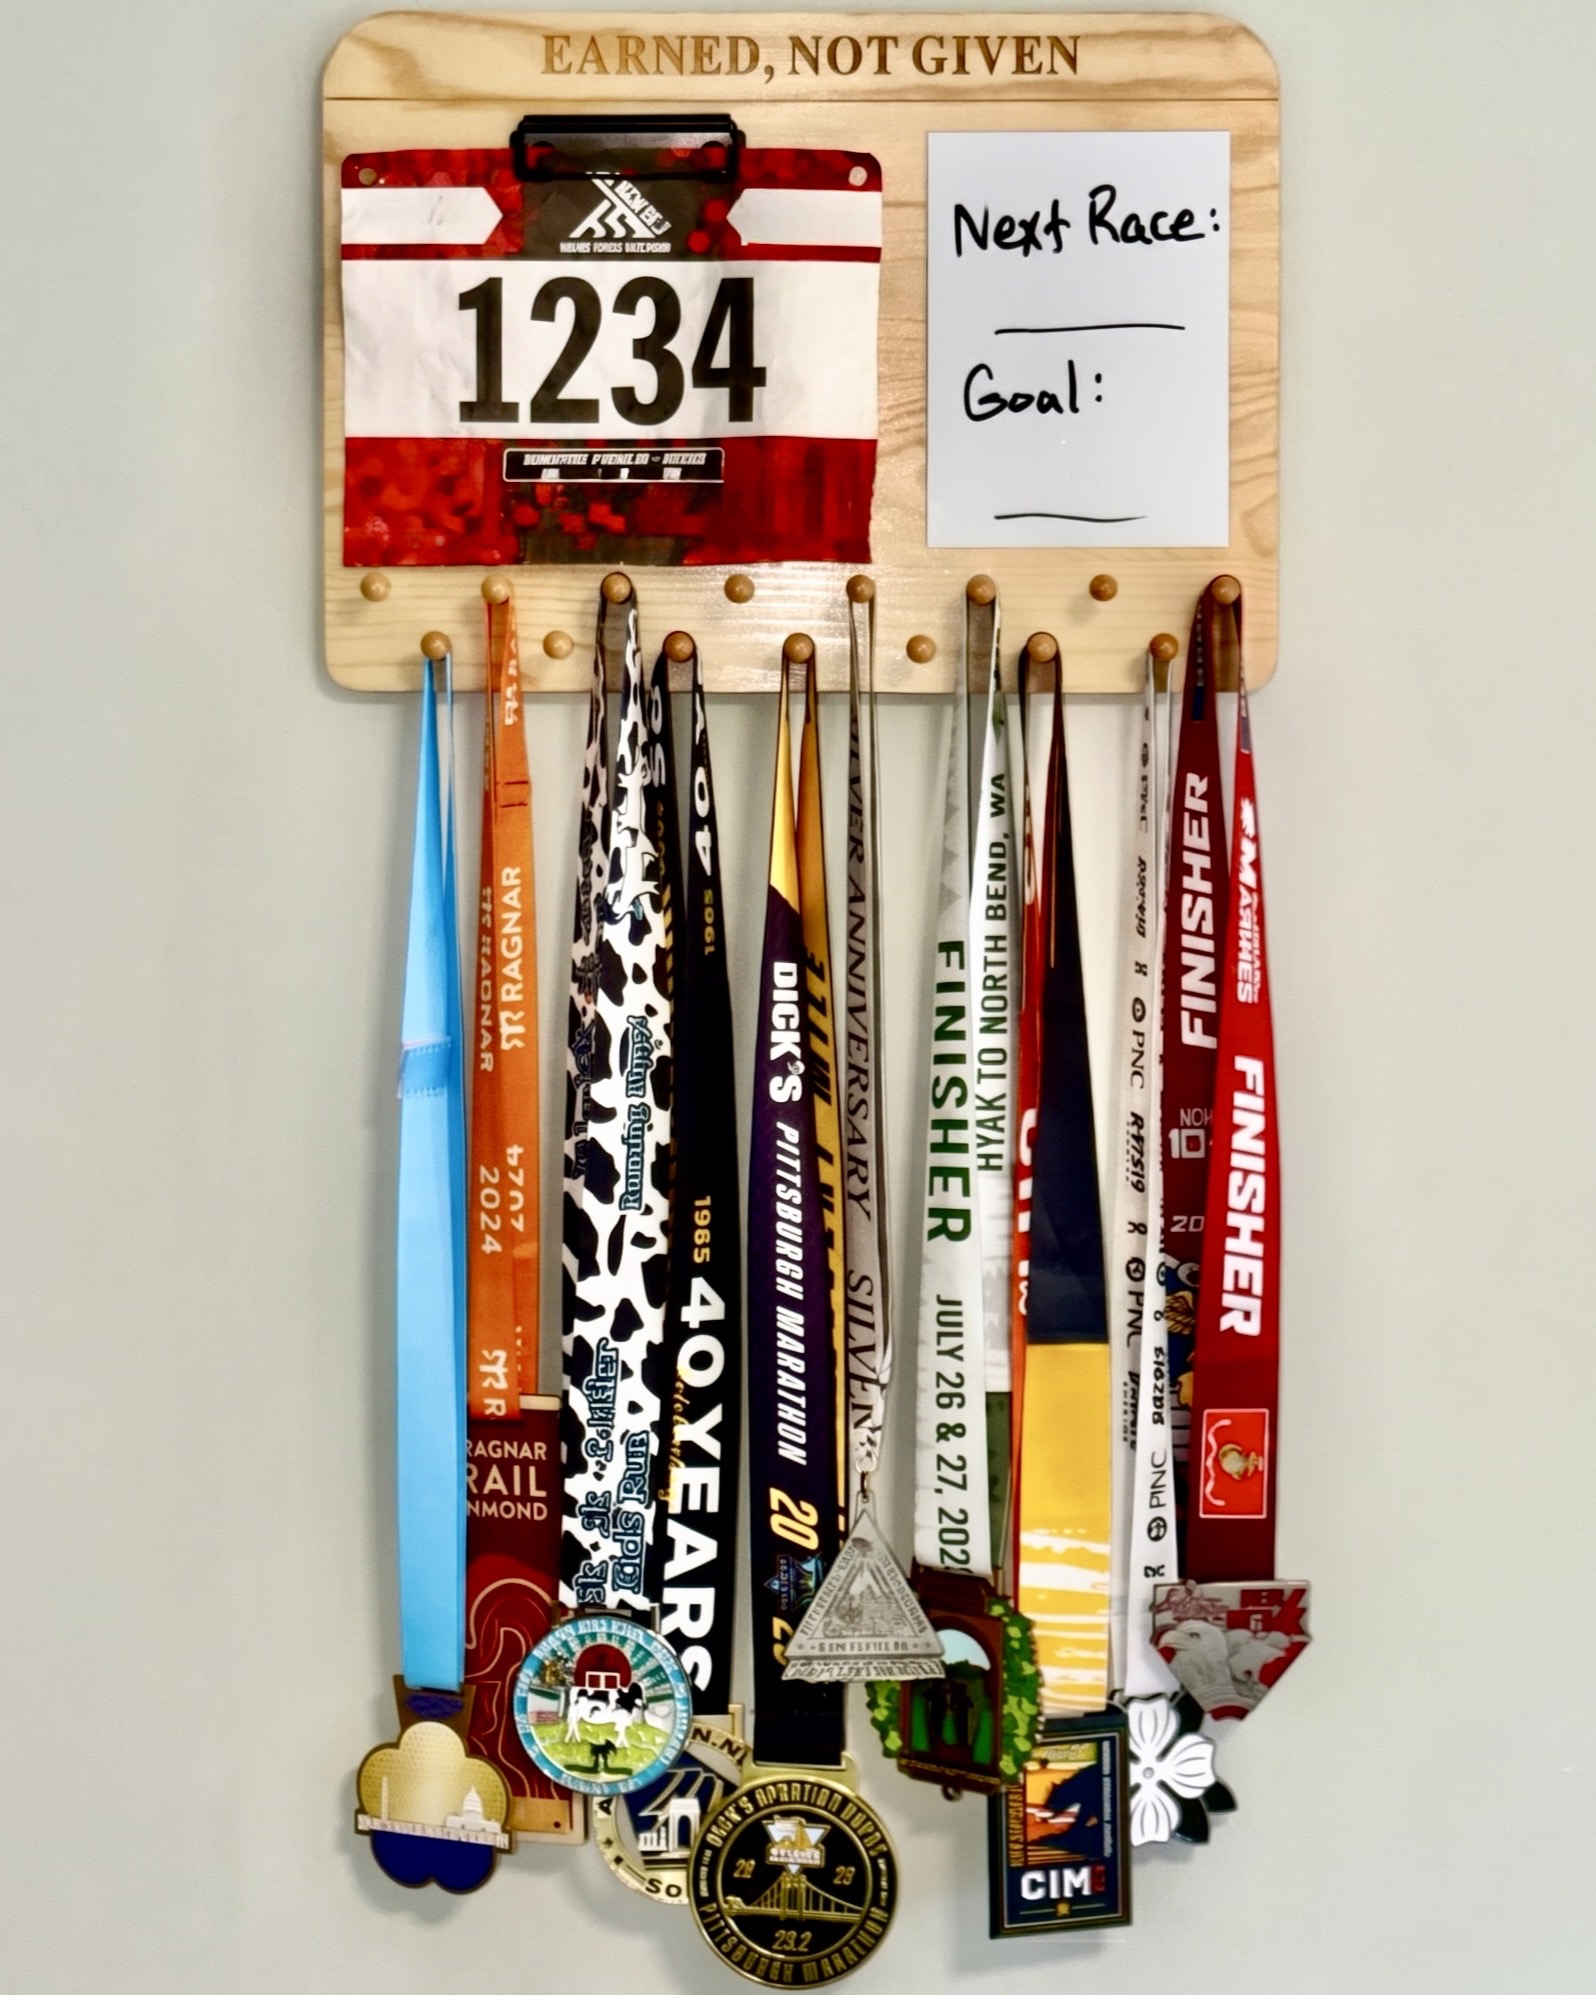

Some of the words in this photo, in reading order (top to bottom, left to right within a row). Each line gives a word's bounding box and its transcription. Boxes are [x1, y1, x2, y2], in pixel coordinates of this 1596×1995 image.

[541, 34, 774, 84] EARNED,
[790, 35, 900, 77] NOT
[911, 34, 1081, 77] GIVEN
[953, 203, 1070, 257] Next
[1088, 185, 1223, 243] Race:
[456, 276, 768, 427] 1234
[962, 361, 1105, 423] Goal:
[990, 772, 1007, 818] WA
[985, 831, 1010, 921] BEND,
[1180, 771, 1217, 1050] FINISHER
[501, 866, 523, 1003] RAGNAR
[979, 932, 1009, 1036] NORTH
[769, 962, 806, 1103] DICK'S
[846, 886, 872, 1220] ANNIVERSARY
[978, 1045, 1008, 1088] TO
[1130, 1031, 1148, 1090] PNC
[926, 939, 972, 1243] FINISHER
[977, 1092, 1007, 1171] HYAK
[480, 1166, 502, 1254] 2024
[776, 1121, 805, 1302] PITTSBURGH
[1219, 1055, 1265, 1337] FINISHER
[936, 1294, 964, 1363] JULY
[775, 1305, 808, 1466] MARATHON
[935, 1372, 966, 1410] 26
[934, 1454, 968, 1495] 27,
[935, 1423, 967, 1444] &
[769, 1486, 820, 1552] 20
